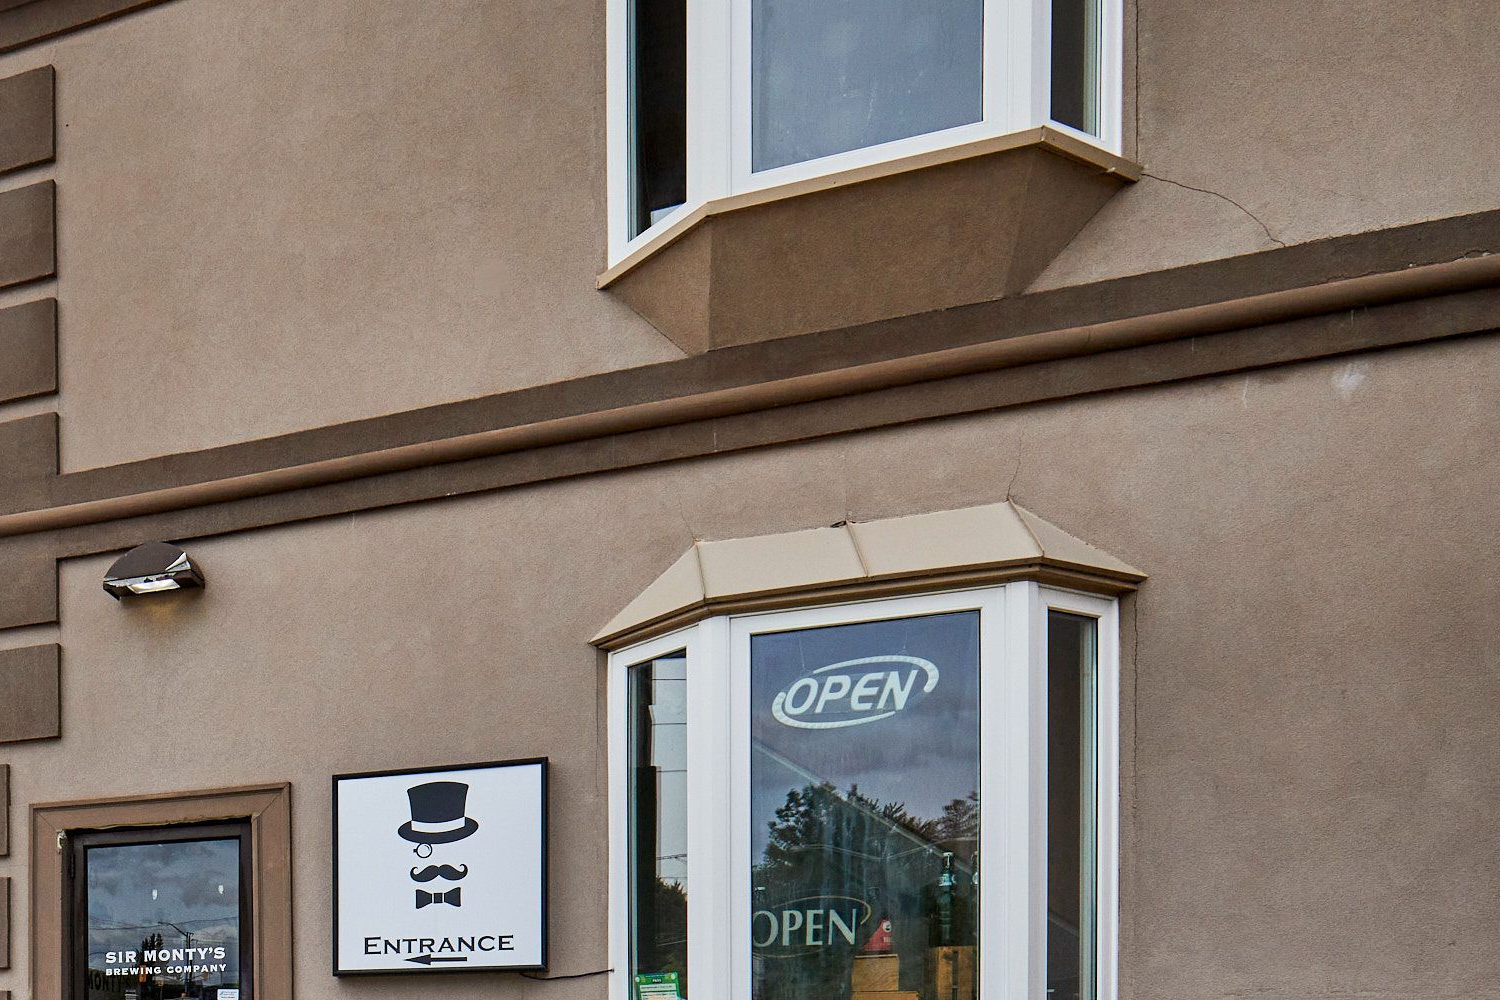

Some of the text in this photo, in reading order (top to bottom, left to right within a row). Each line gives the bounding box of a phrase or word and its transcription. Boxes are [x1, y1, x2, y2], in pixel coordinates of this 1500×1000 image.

[784, 669, 918, 715] OPEN
[752, 908, 857, 948] OPEN
[105, 946, 226, 964] SIR MONTY'S
[364, 934, 515, 955] ENTRANCE
[105, 963, 227, 976] BREWING COMPANY
